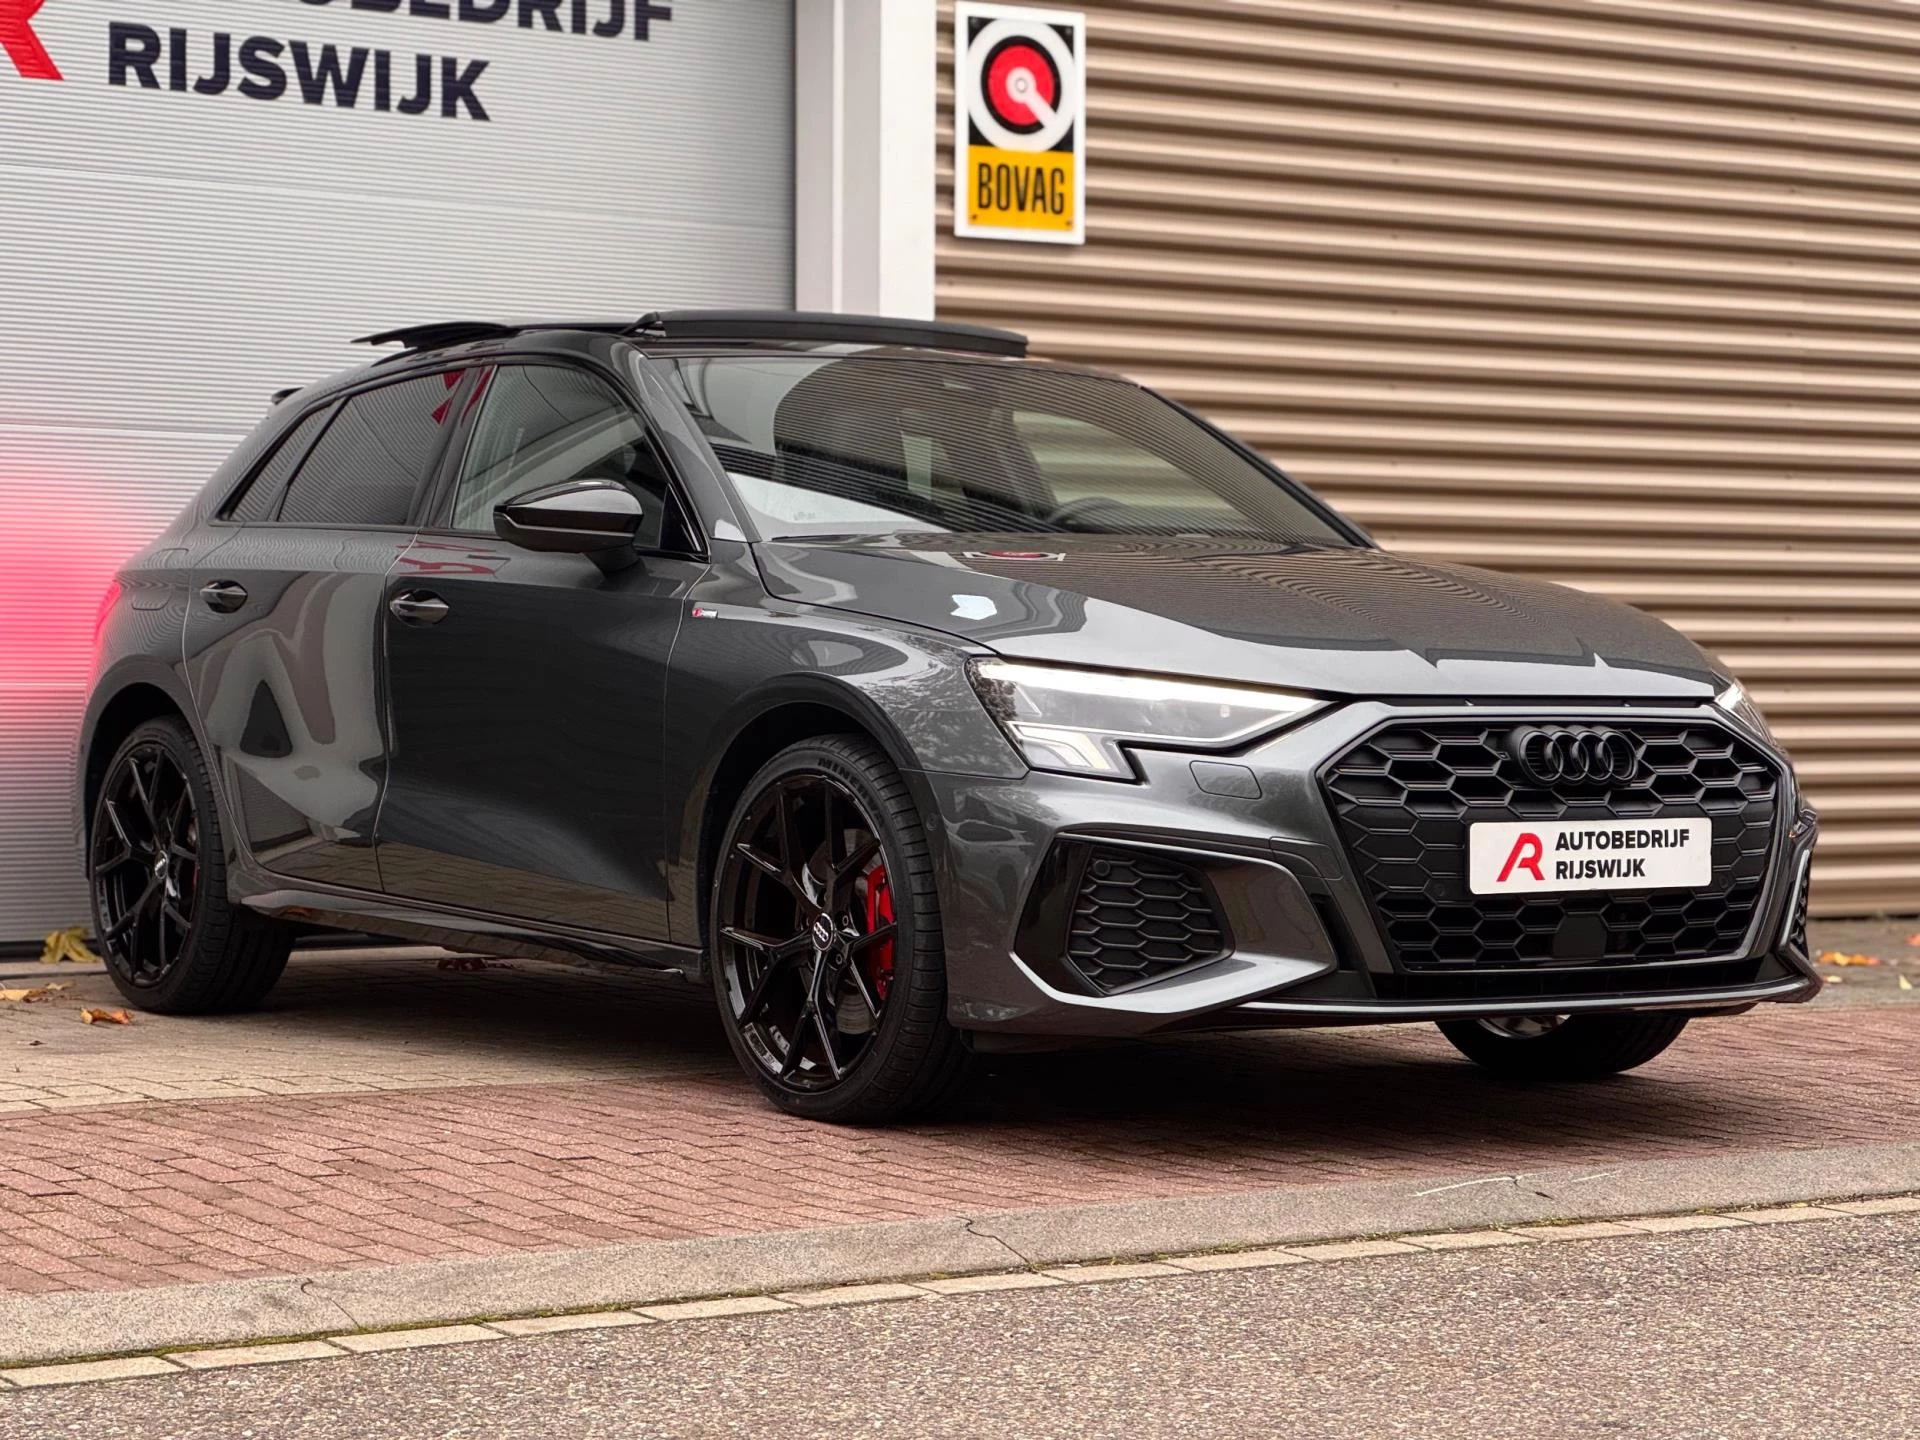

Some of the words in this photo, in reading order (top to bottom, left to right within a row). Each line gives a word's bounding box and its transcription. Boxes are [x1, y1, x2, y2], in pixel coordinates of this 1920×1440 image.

[108, 21, 491, 121] RIJSWIJK
[977, 162, 1065, 215] BOVAG
[1555, 829, 1690, 851] AUTOBEDRIJF
[1555, 858, 1646, 880] RIJSWIJK
